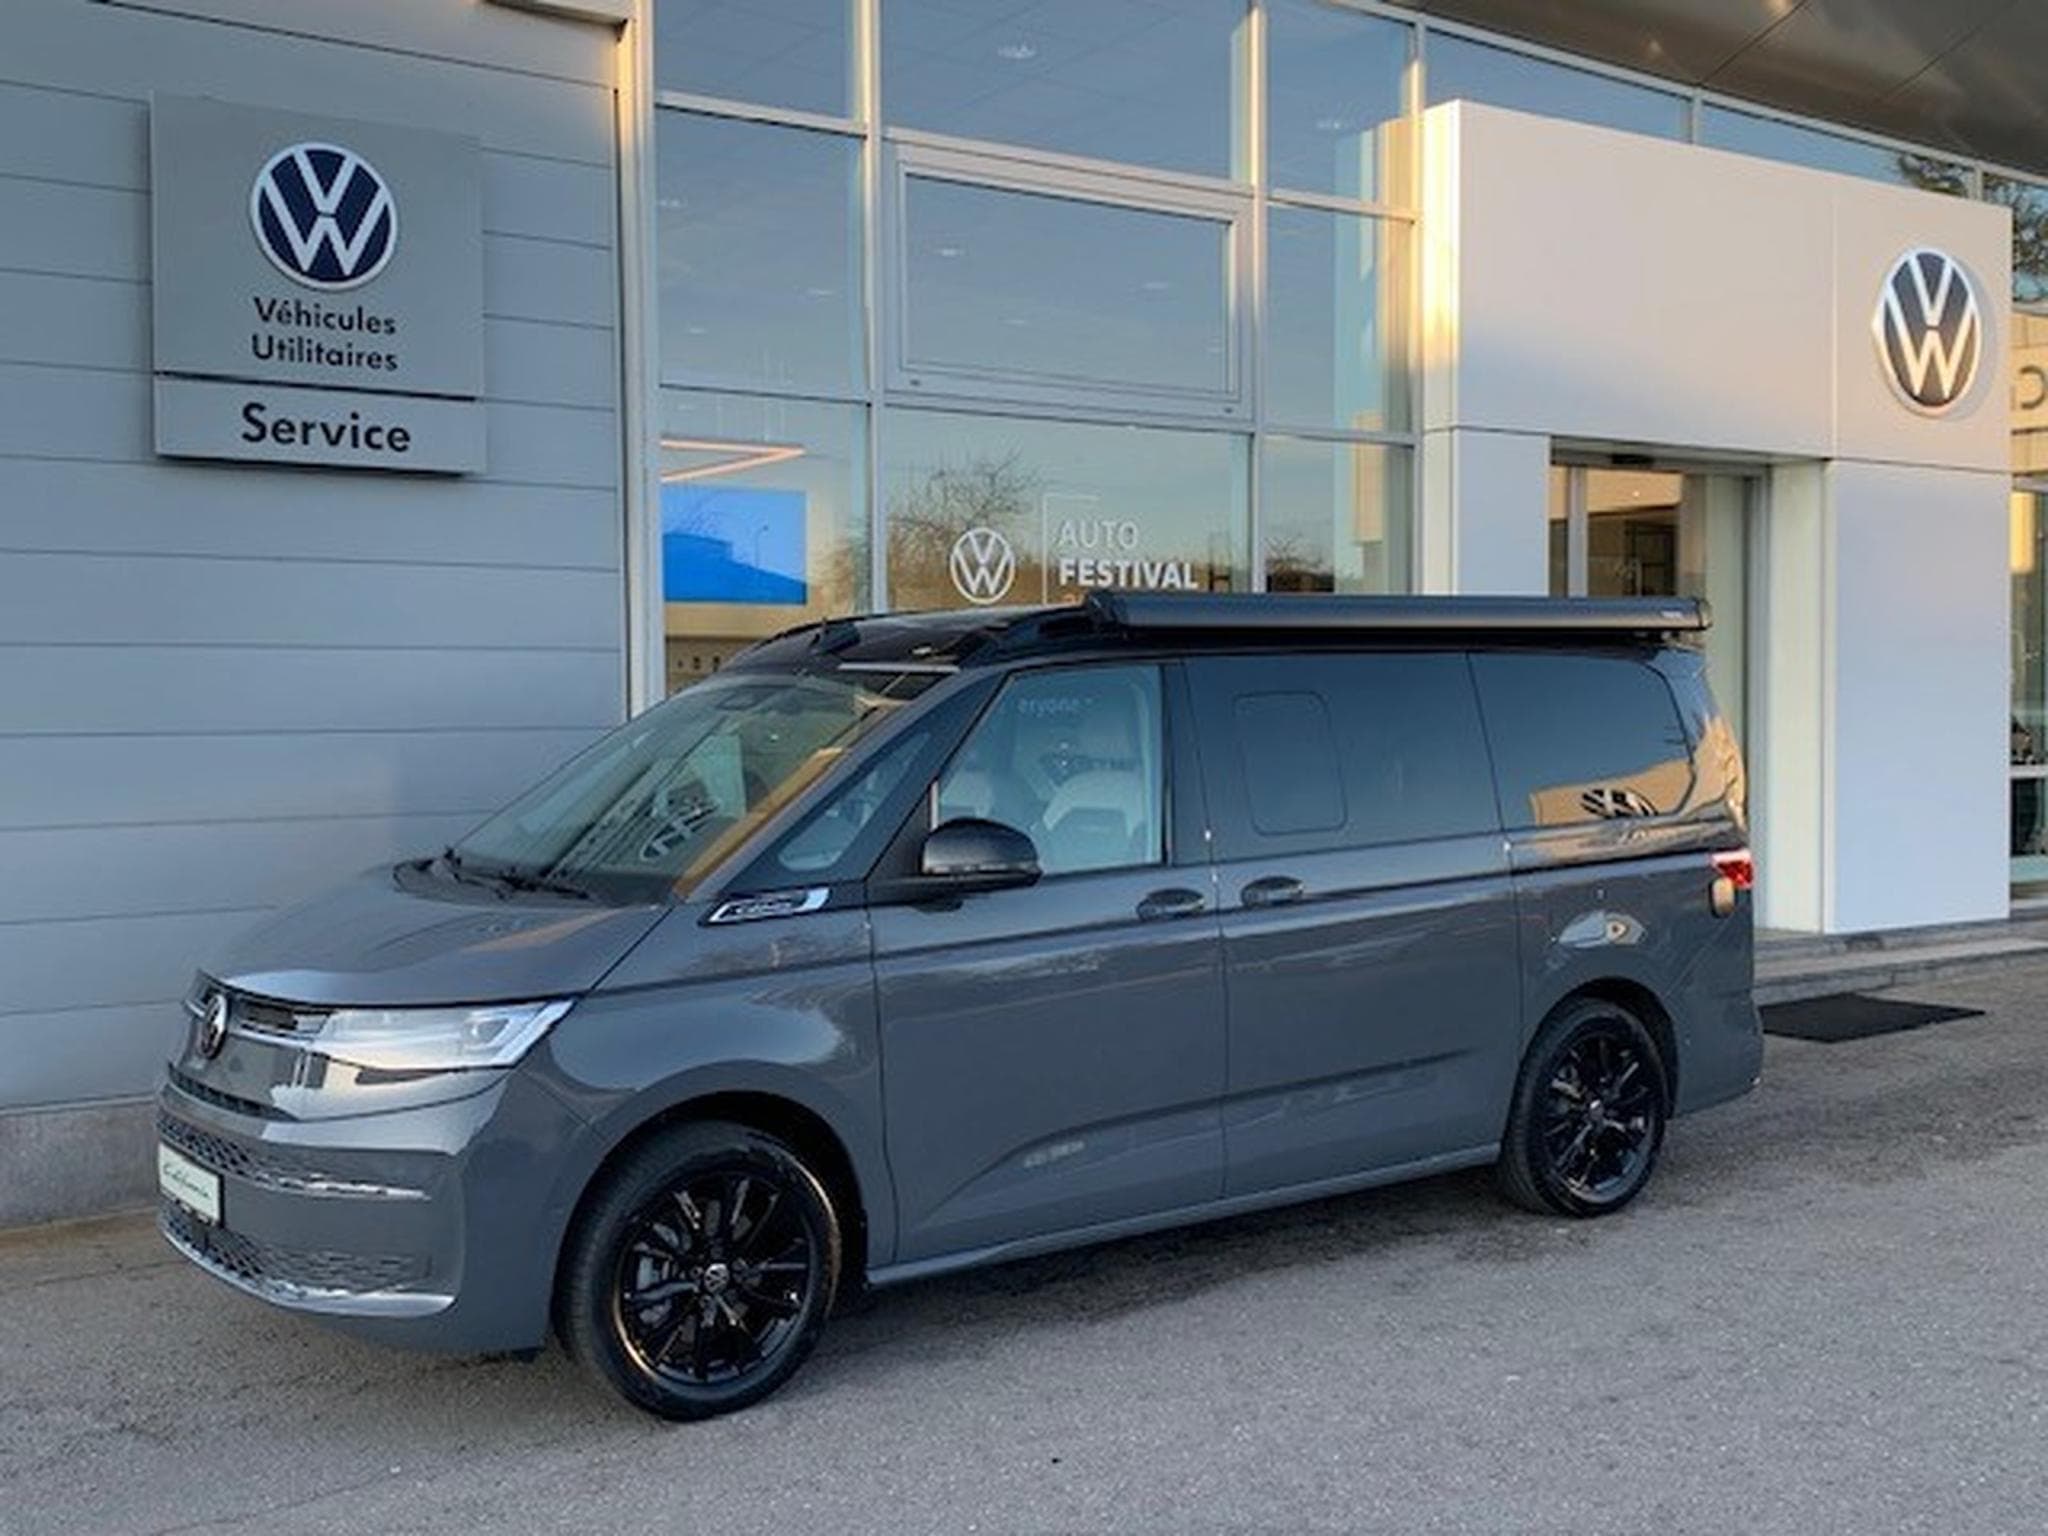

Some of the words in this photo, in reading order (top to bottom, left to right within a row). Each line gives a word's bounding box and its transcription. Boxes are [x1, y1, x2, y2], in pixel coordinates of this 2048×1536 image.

[254, 146, 394, 284] VW
[253, 296, 396, 335] Véhicules
[1878, 248, 1980, 408] VW
[252, 333, 398, 371] Utilitaires
[242, 402, 411, 452] Service
[1057, 519, 1138, 549] AUTO
[951, 528, 1015, 602] VW
[1058, 558, 1198, 590] FESTIVAL
